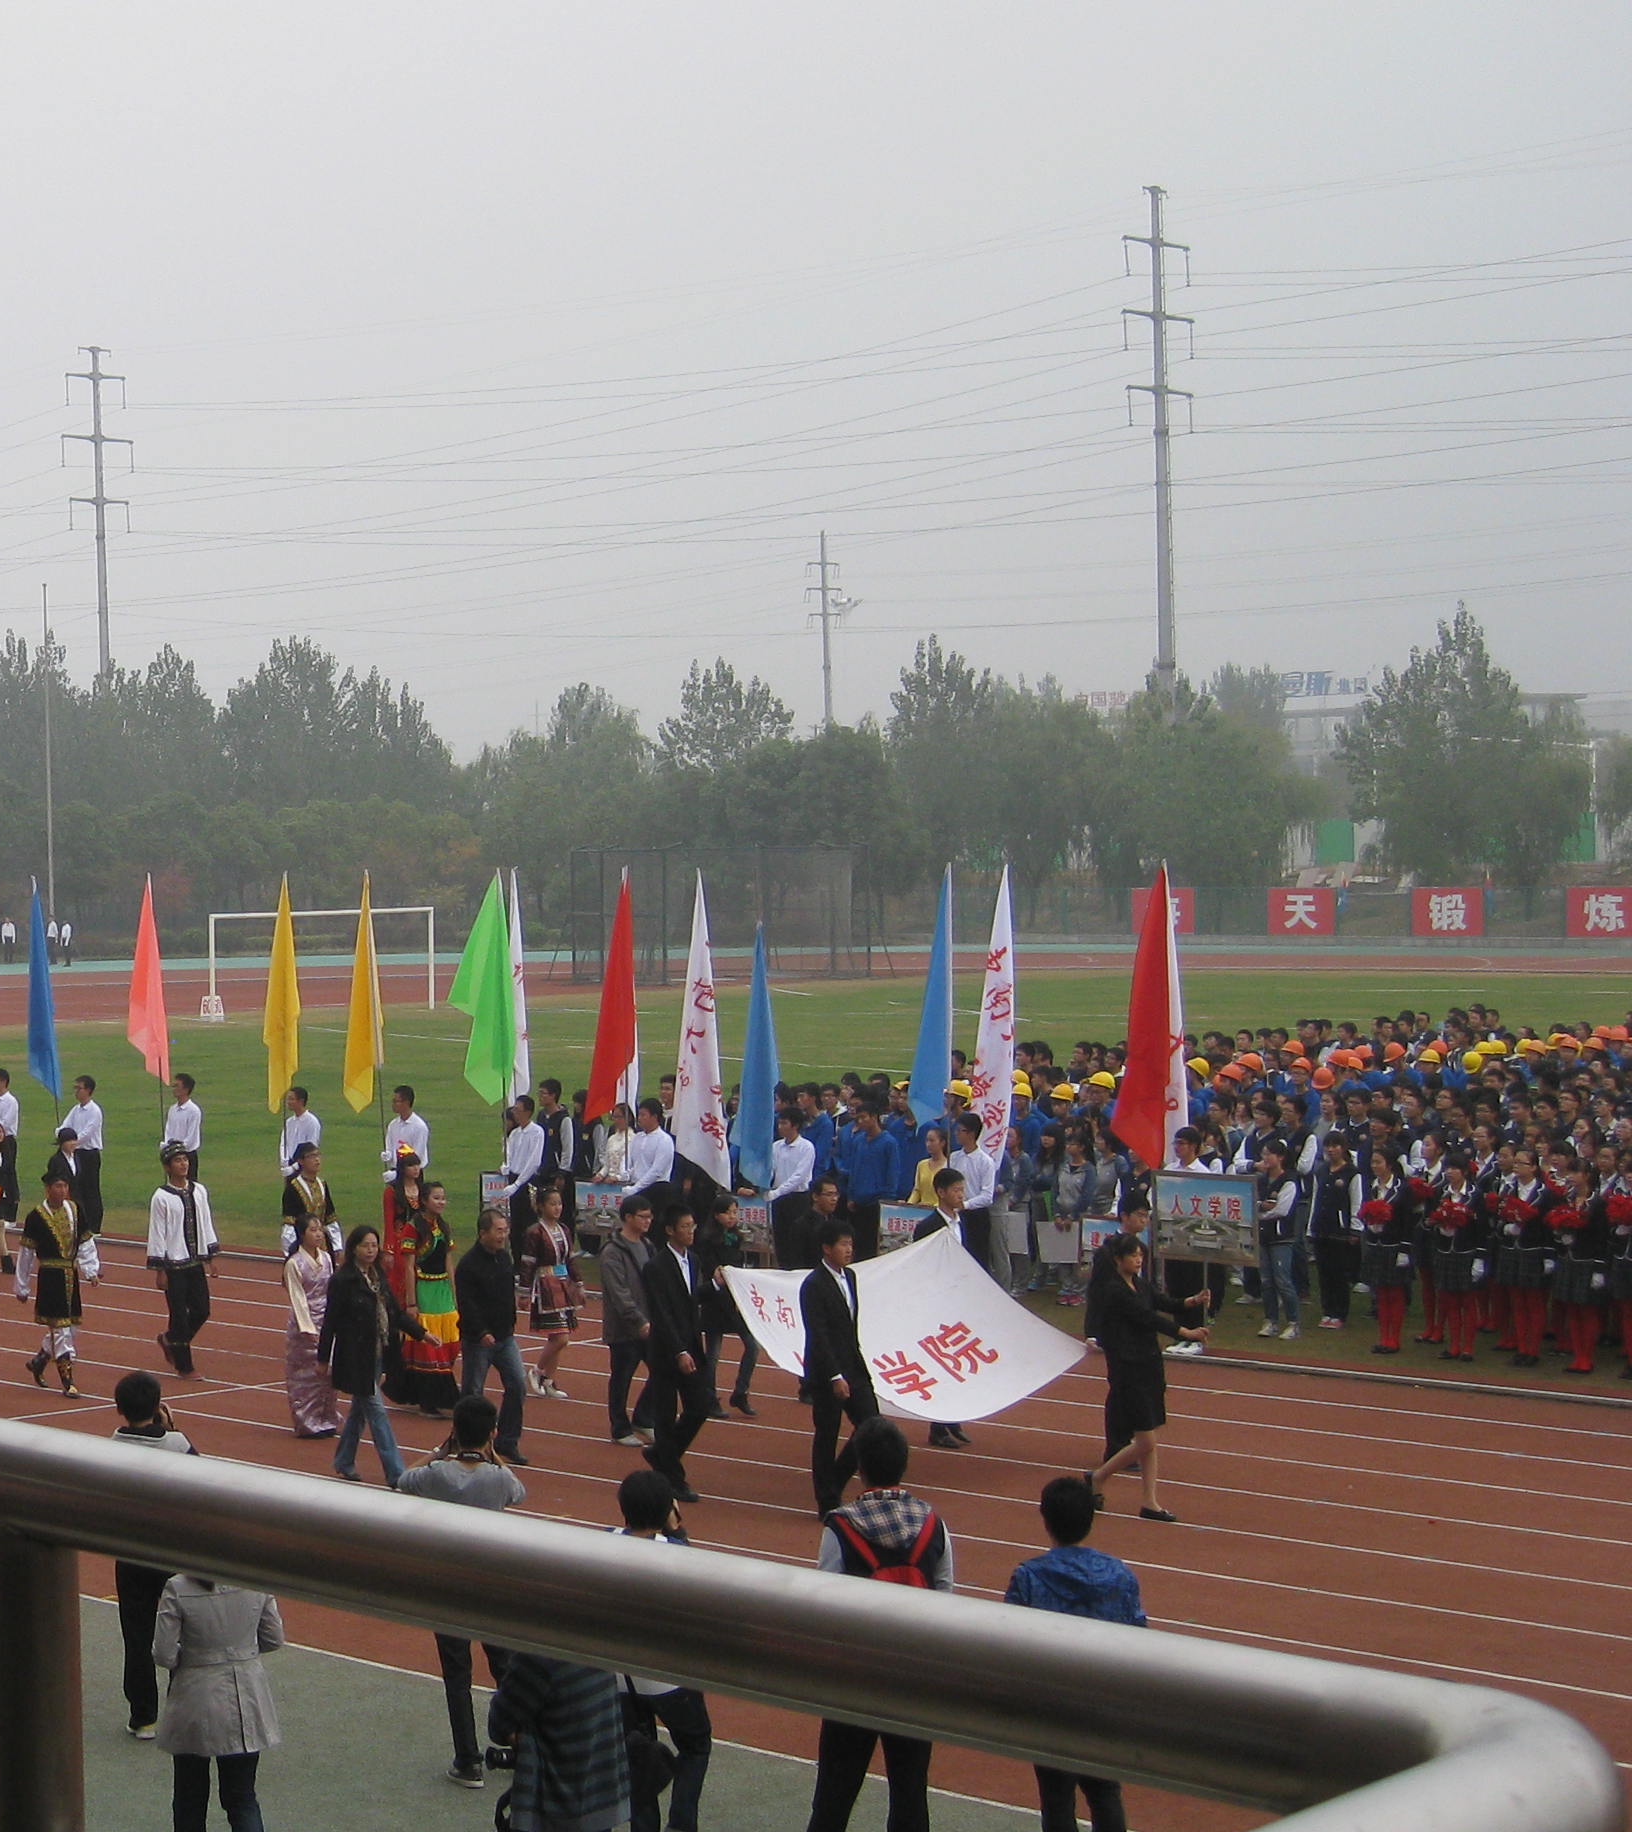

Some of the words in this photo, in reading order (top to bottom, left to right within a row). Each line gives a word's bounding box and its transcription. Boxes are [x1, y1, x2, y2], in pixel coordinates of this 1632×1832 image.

[1284, 895, 1318, 930] 天
[1429, 894, 1466, 931] 锻
[1584, 894, 1626, 932] 炼
[1171, 1194, 1241, 1220] 人文学院
[872, 1321, 999, 1401] 学院
